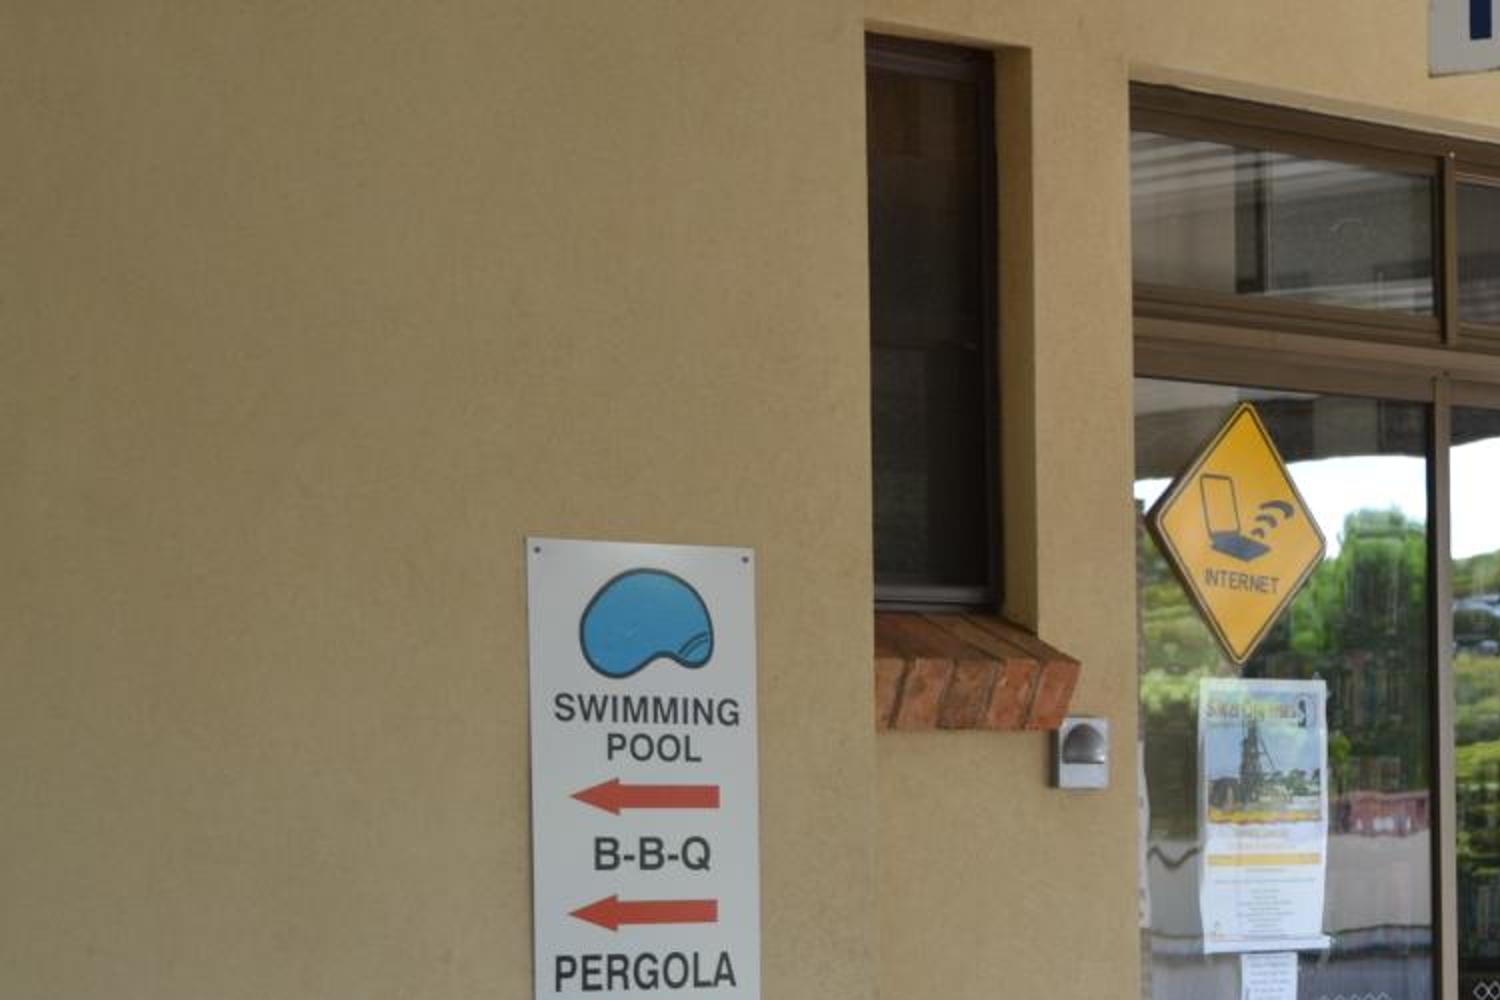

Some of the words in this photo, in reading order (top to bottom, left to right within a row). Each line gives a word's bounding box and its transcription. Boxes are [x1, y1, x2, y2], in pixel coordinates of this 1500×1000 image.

[1204, 567, 1280, 594] INTERNET
[553, 692, 740, 727] SWIMMING
[606, 732, 702, 763] POOL
[592, 835, 712, 872] B-B-Q
[554, 950, 737, 993] PERGOLA
